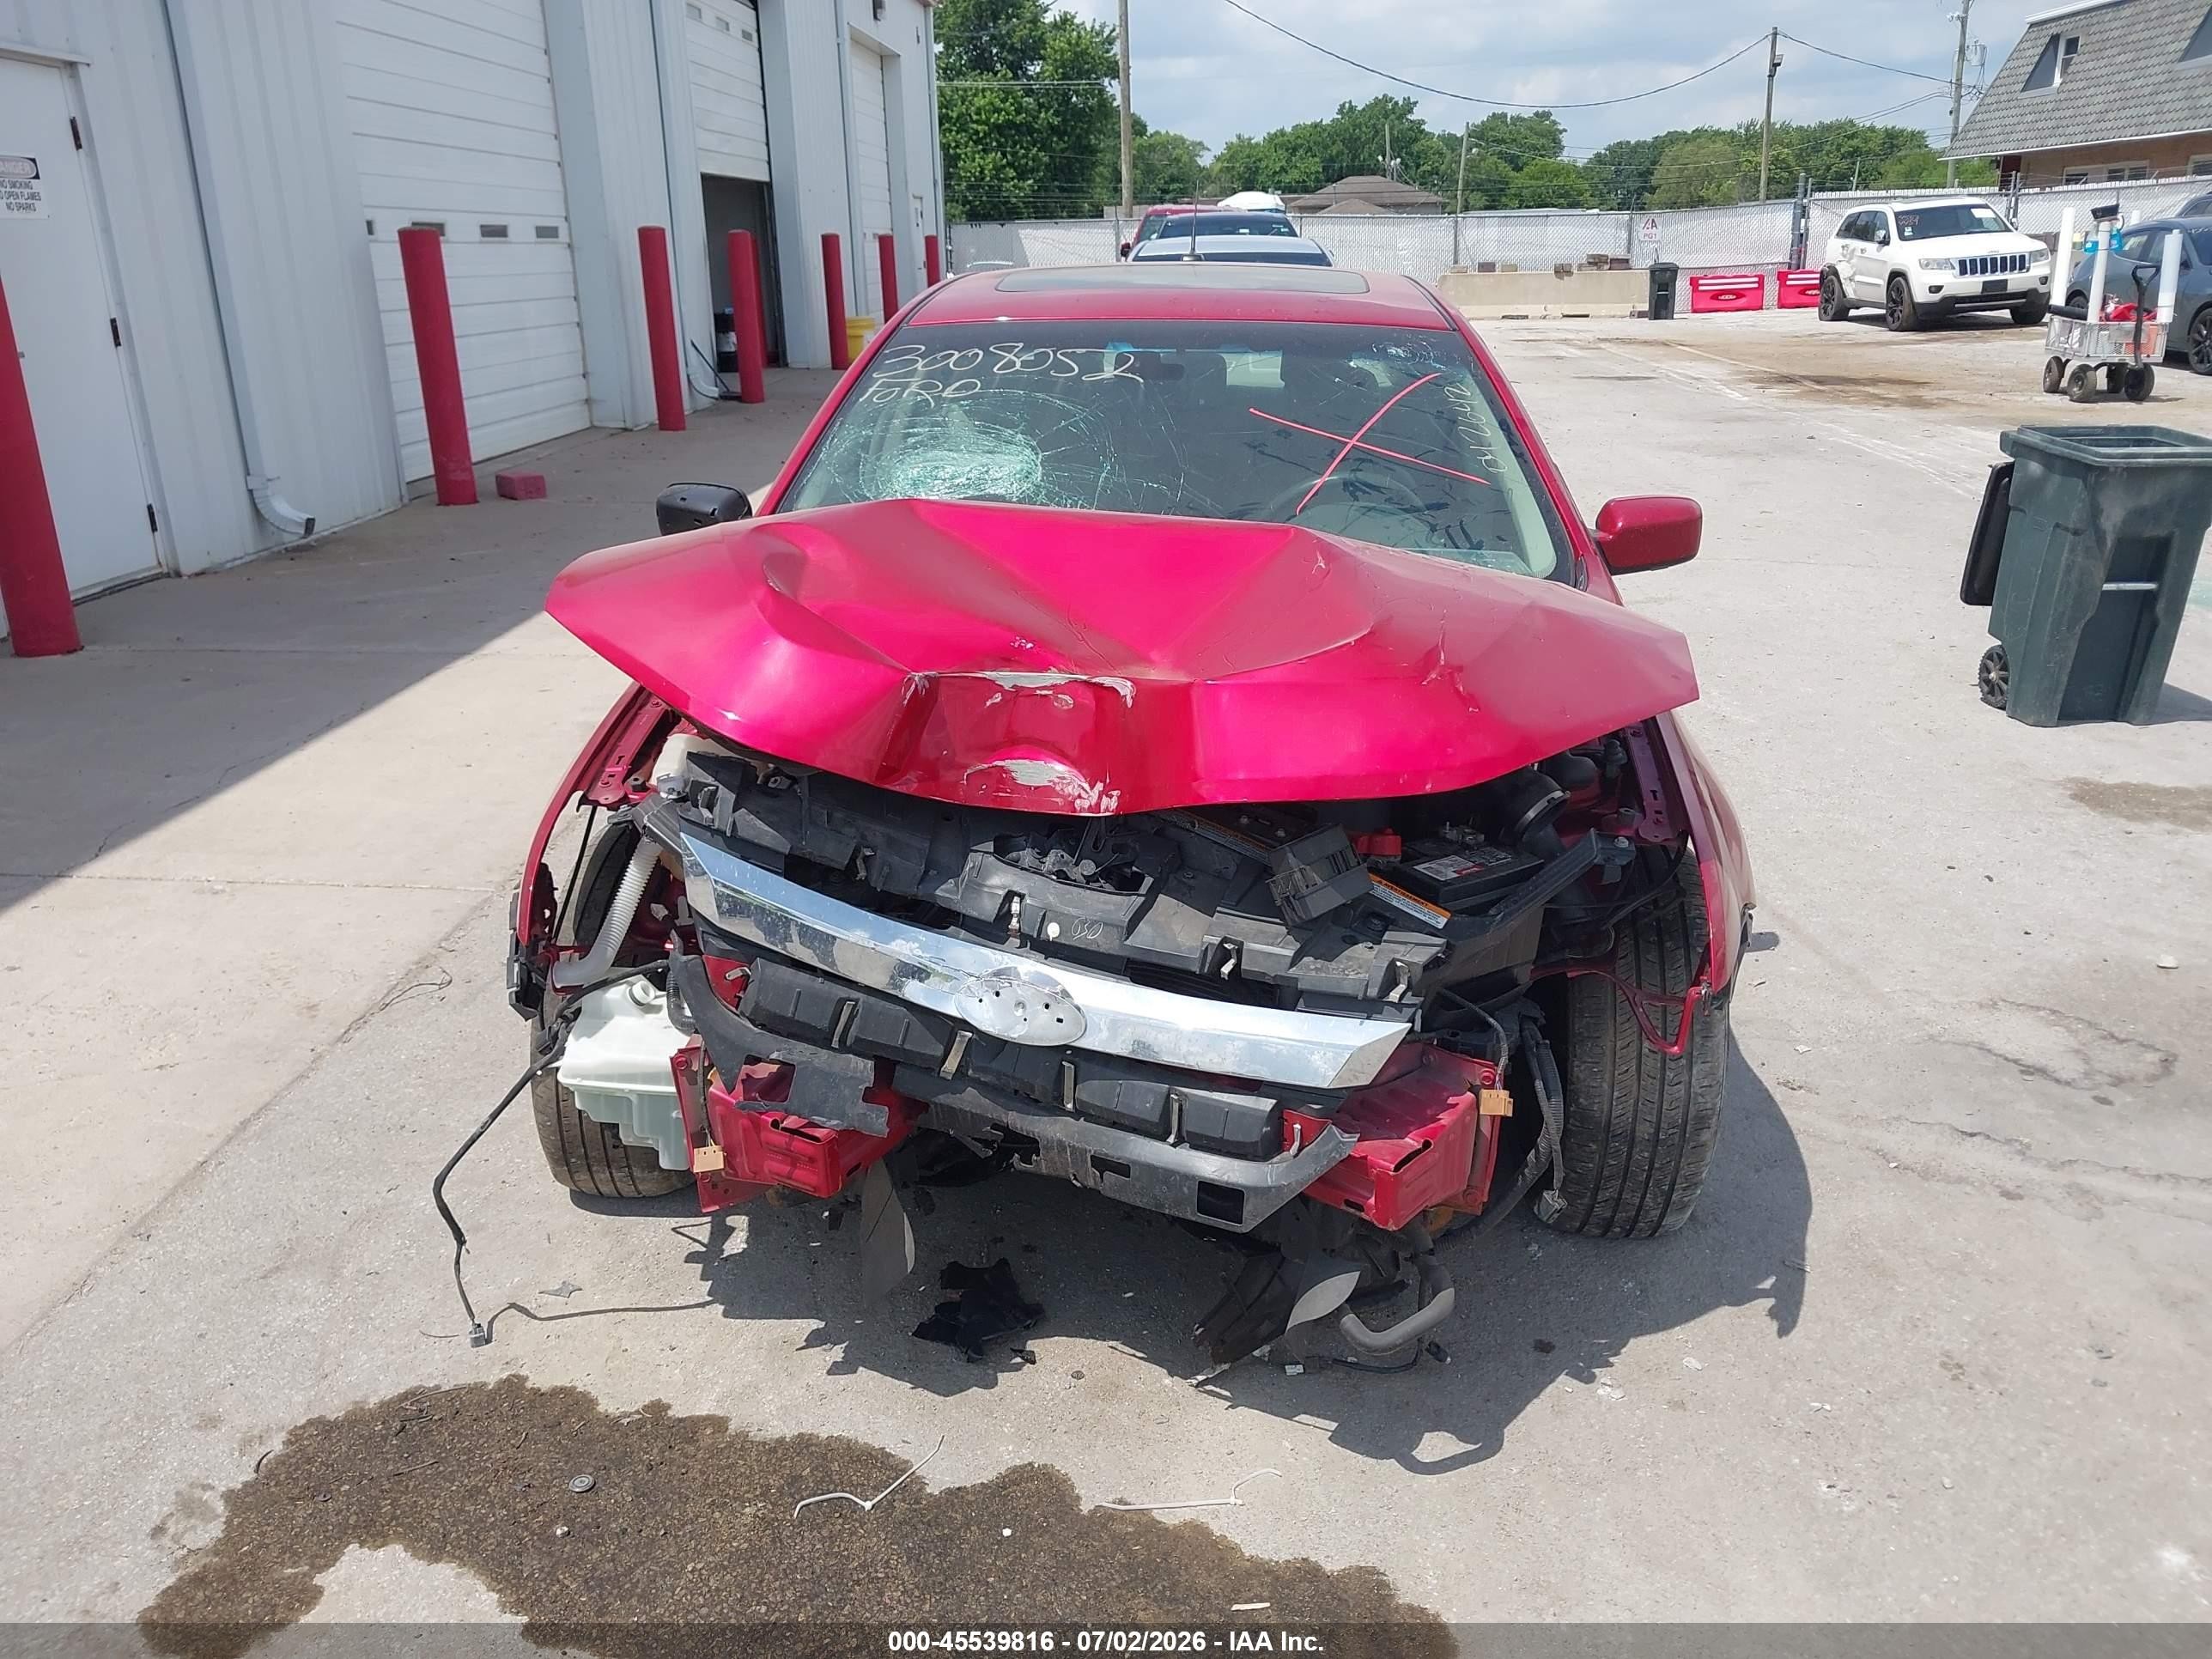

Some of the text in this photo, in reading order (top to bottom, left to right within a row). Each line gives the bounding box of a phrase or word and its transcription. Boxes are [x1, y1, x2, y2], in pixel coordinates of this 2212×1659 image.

[0, 161, 32, 174] ANGER
[8, 179, 33, 190] SMOKING
[4, 191, 20, 200] OPEN
[20, 191, 41, 202] FLAMES
[6, 202, 36, 212] NO SPARKS
[872, 343, 1144, 383] 3008052
